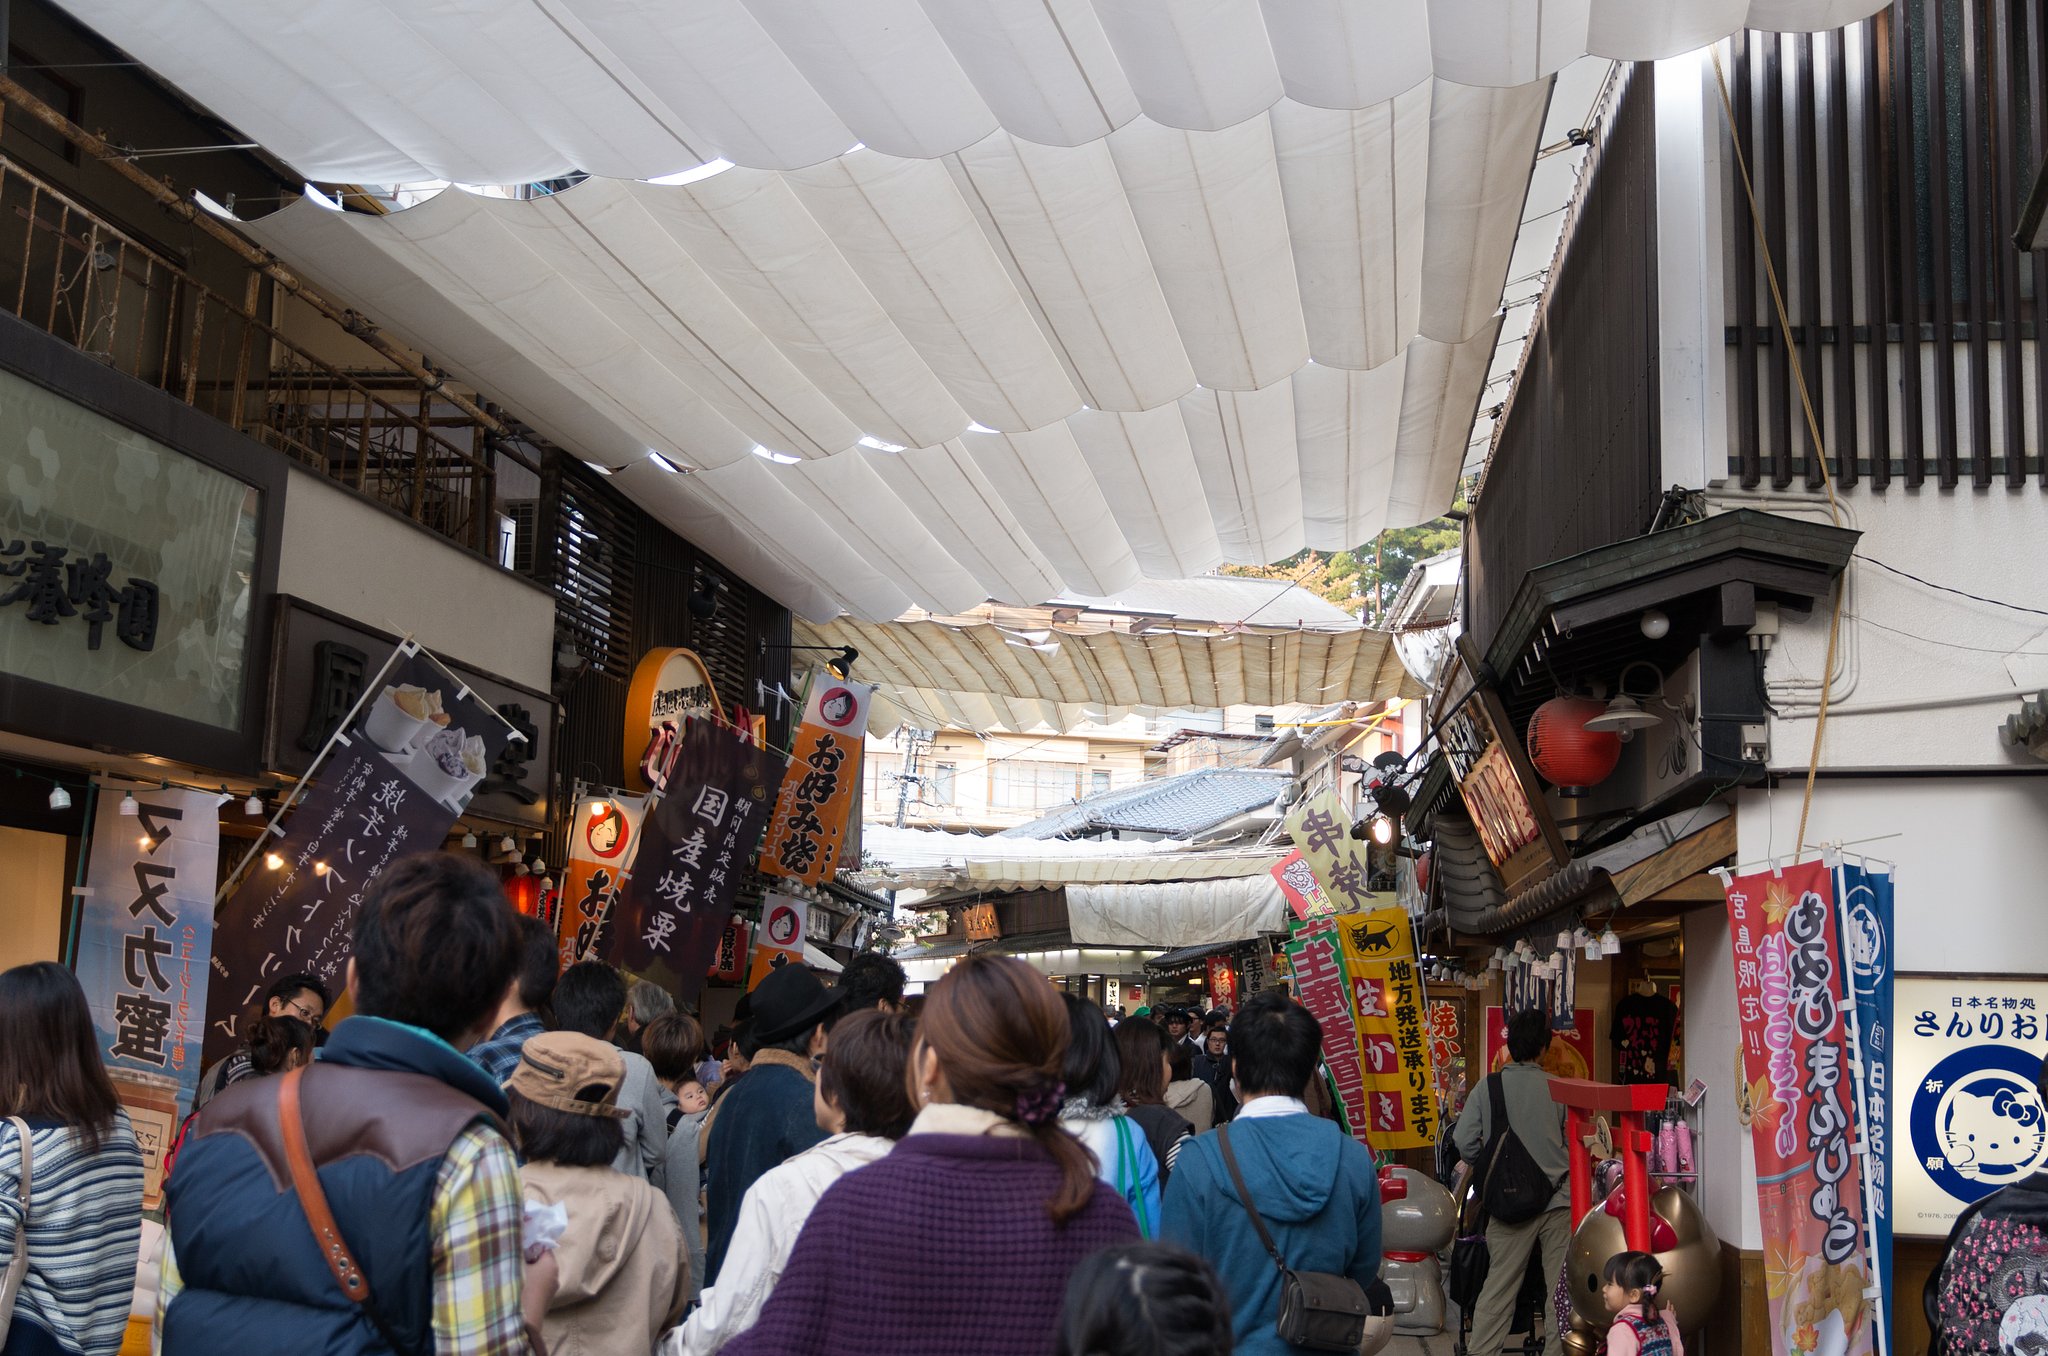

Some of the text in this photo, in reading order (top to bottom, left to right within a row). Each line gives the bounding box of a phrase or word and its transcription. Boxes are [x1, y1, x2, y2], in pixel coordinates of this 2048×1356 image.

[702, 796, 753, 905] 期間限定販売
[778, 732, 846, 875] お好み焼
[641, 783, 731, 953] 国産焼栗
[1245, 958, 1263, 992] 生かき
[1914, 1010, 2048, 1042] さんりお
[1951, 996, 2037, 1010] 日本名物処
[1356, 978, 1397, 1132] 生かき
[1388, 960, 1436, 1143] 地方発送承ります。
